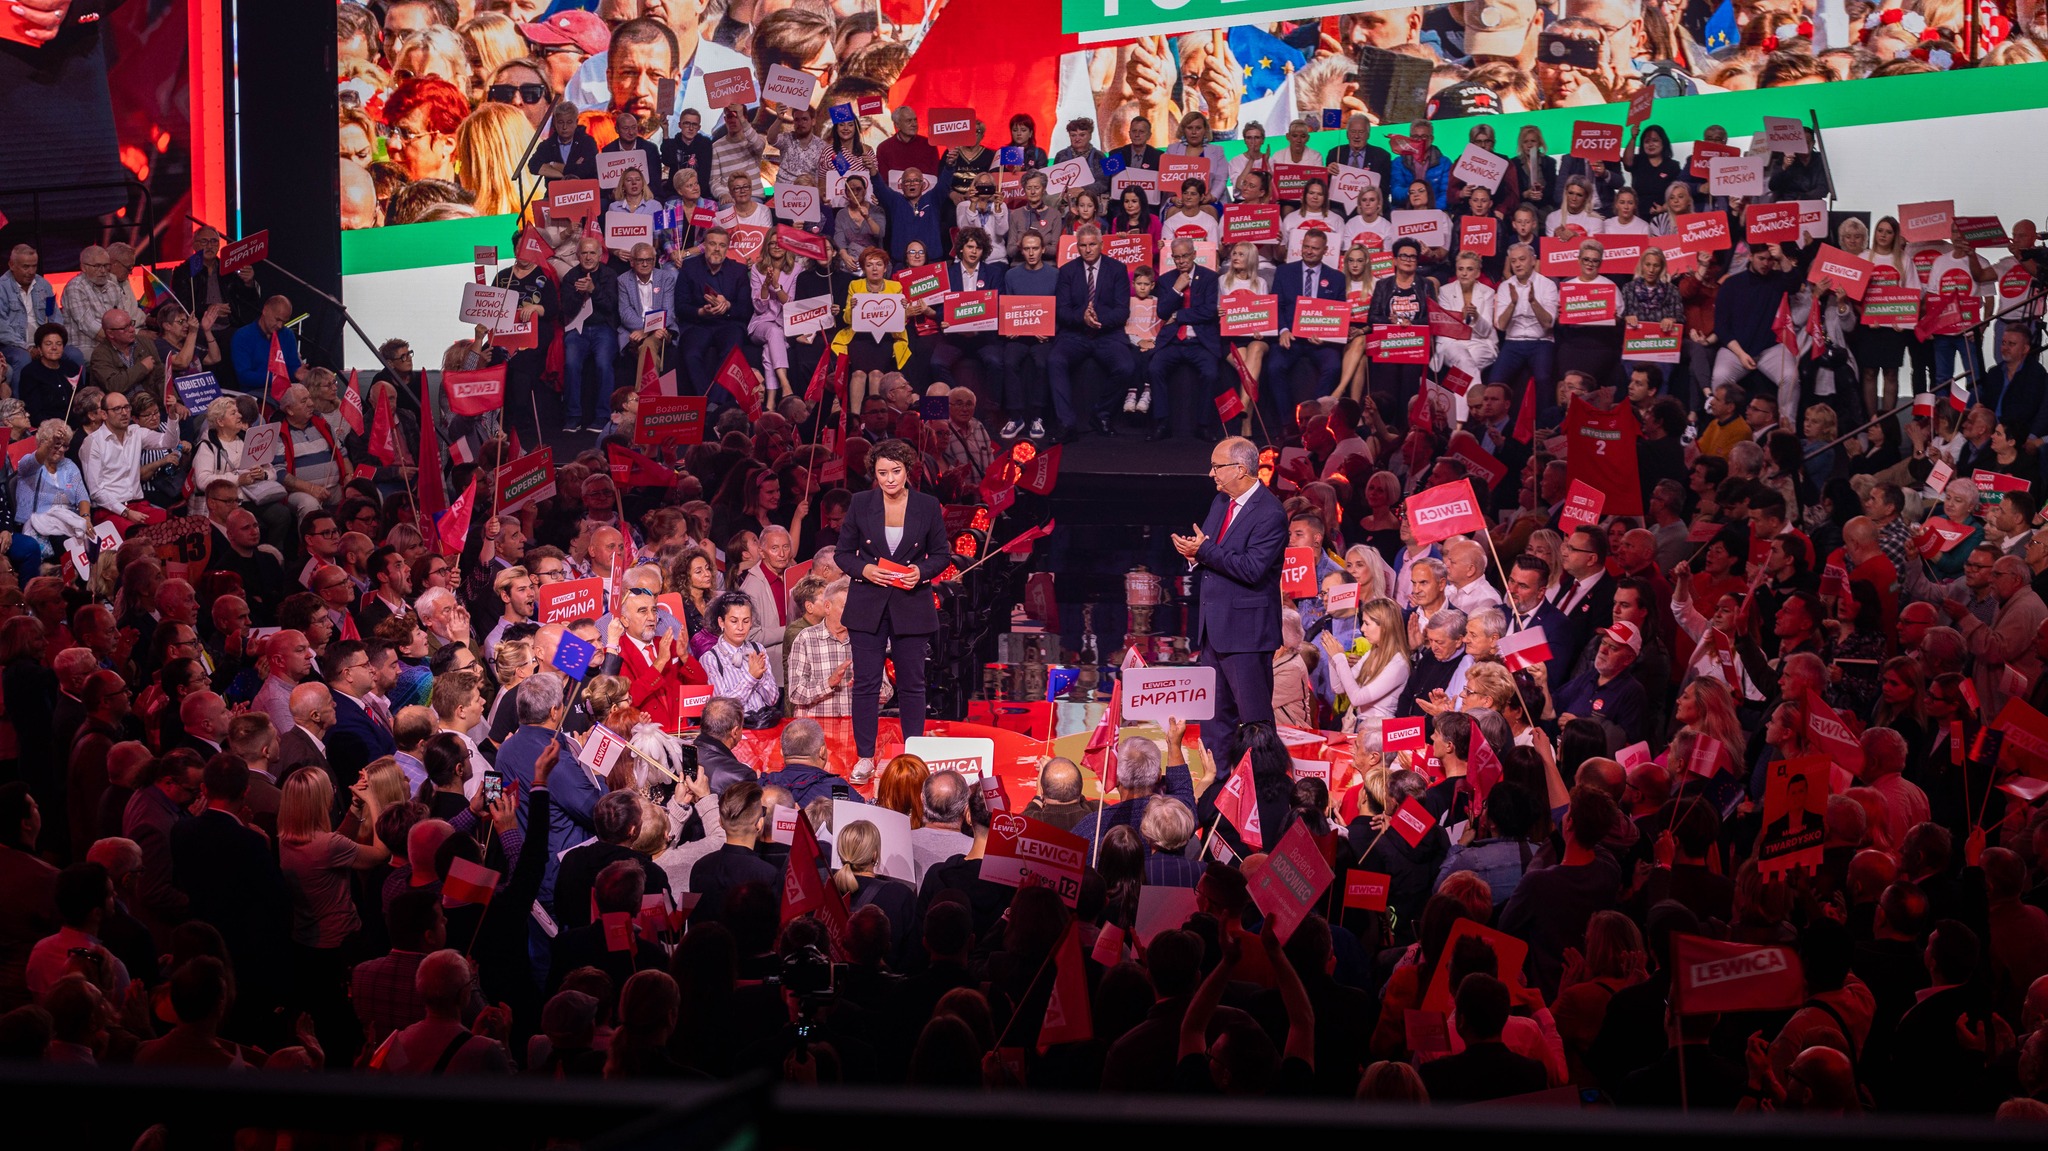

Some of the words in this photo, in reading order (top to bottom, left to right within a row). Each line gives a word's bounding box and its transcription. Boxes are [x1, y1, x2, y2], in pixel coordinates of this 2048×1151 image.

[711, 81, 750, 99] RÓWNOŚĆ
[768, 82, 809, 97] WOLNOŚĆ
[935, 121, 968, 134] LEWICA
[1575, 138, 1618, 150] POSTĘP
[1460, 161, 1499, 181] RÓWNOŚĆ
[1051, 174, 1076, 185] LEWEJ
[1118, 181, 1154, 189] LEWICA
[1716, 172, 1756, 185] TROSKA
[556, 192, 593, 205] LEWICA
[783, 200, 806, 208] LEWEJ
[1230, 220, 1270, 230] ADAMCZYK
[1751, 216, 1795, 234] RÓWNOŚĆ
[1909, 215, 1946, 228] LEWICA
[613, 227, 647, 235] LEWICA
[1399, 222, 1436, 235] LEWICA
[1682, 224, 1725, 243] RÓWNOŚĆ
[729, 240, 756, 248] LEWEJ
[1464, 233, 1492, 245] POSTĘP
[224, 242, 265, 267] EMPATIA
[1551, 252, 1579, 262] LEWIC
[1824, 262, 1861, 280] LEWICA
[911, 280, 939, 294] MADZIA
[1227, 307, 1248, 315] RAFAŁ
[1566, 300, 1606, 309] ADAMCZYK
[1865, 305, 1916, 313] ADAMCZYKA
[465, 307, 509, 319] CZESNOŚĆ
[791, 307, 827, 325] LEWICA
[861, 311, 888, 319] LEWEJ
[956, 306, 983, 317] MERTA
[1005, 311, 1048, 319] BIELSKO-
[1227, 311, 1268, 323] ADAMCZYK
[1013, 318, 1040, 326] BIAŁA
[1627, 339, 1676, 349] KOBIELUSZ
[177, 379, 206, 390] KOBIETO
[207, 376, 216, 385] !!!
[656, 404, 689, 414] Bożena
[644, 412, 697, 425] BOROWIEC
[248, 443, 267, 455] LEWEJ
[1596, 441, 1606, 455] 2
[505, 470, 546, 500] KOPERSKI
[1564, 506, 1597, 524] SZACUNEK
[178, 533, 205, 563] 13
[553, 594, 574, 604] LEWICA
[579, 589, 588, 598] TO
[1332, 591, 1355, 602] LEWICA
[548, 599, 595, 622] ZMIANA
[1144, 681, 1175, 689] LEWICA
[1131, 688, 1206, 707] EMPATIA
[1389, 728, 1419, 740] LEWICA
[594, 738, 610, 766] LEWICA
[1764, 831, 1822, 855] TWARDYSKO
[1021, 841, 1079, 866] LEWICA
[1272, 855, 1312, 904] BOROWIEC
[1060, 877, 1078, 898] 12
[1349, 886, 1382, 894] LEWICA
[1696, 950, 1783, 982] LEWICA
